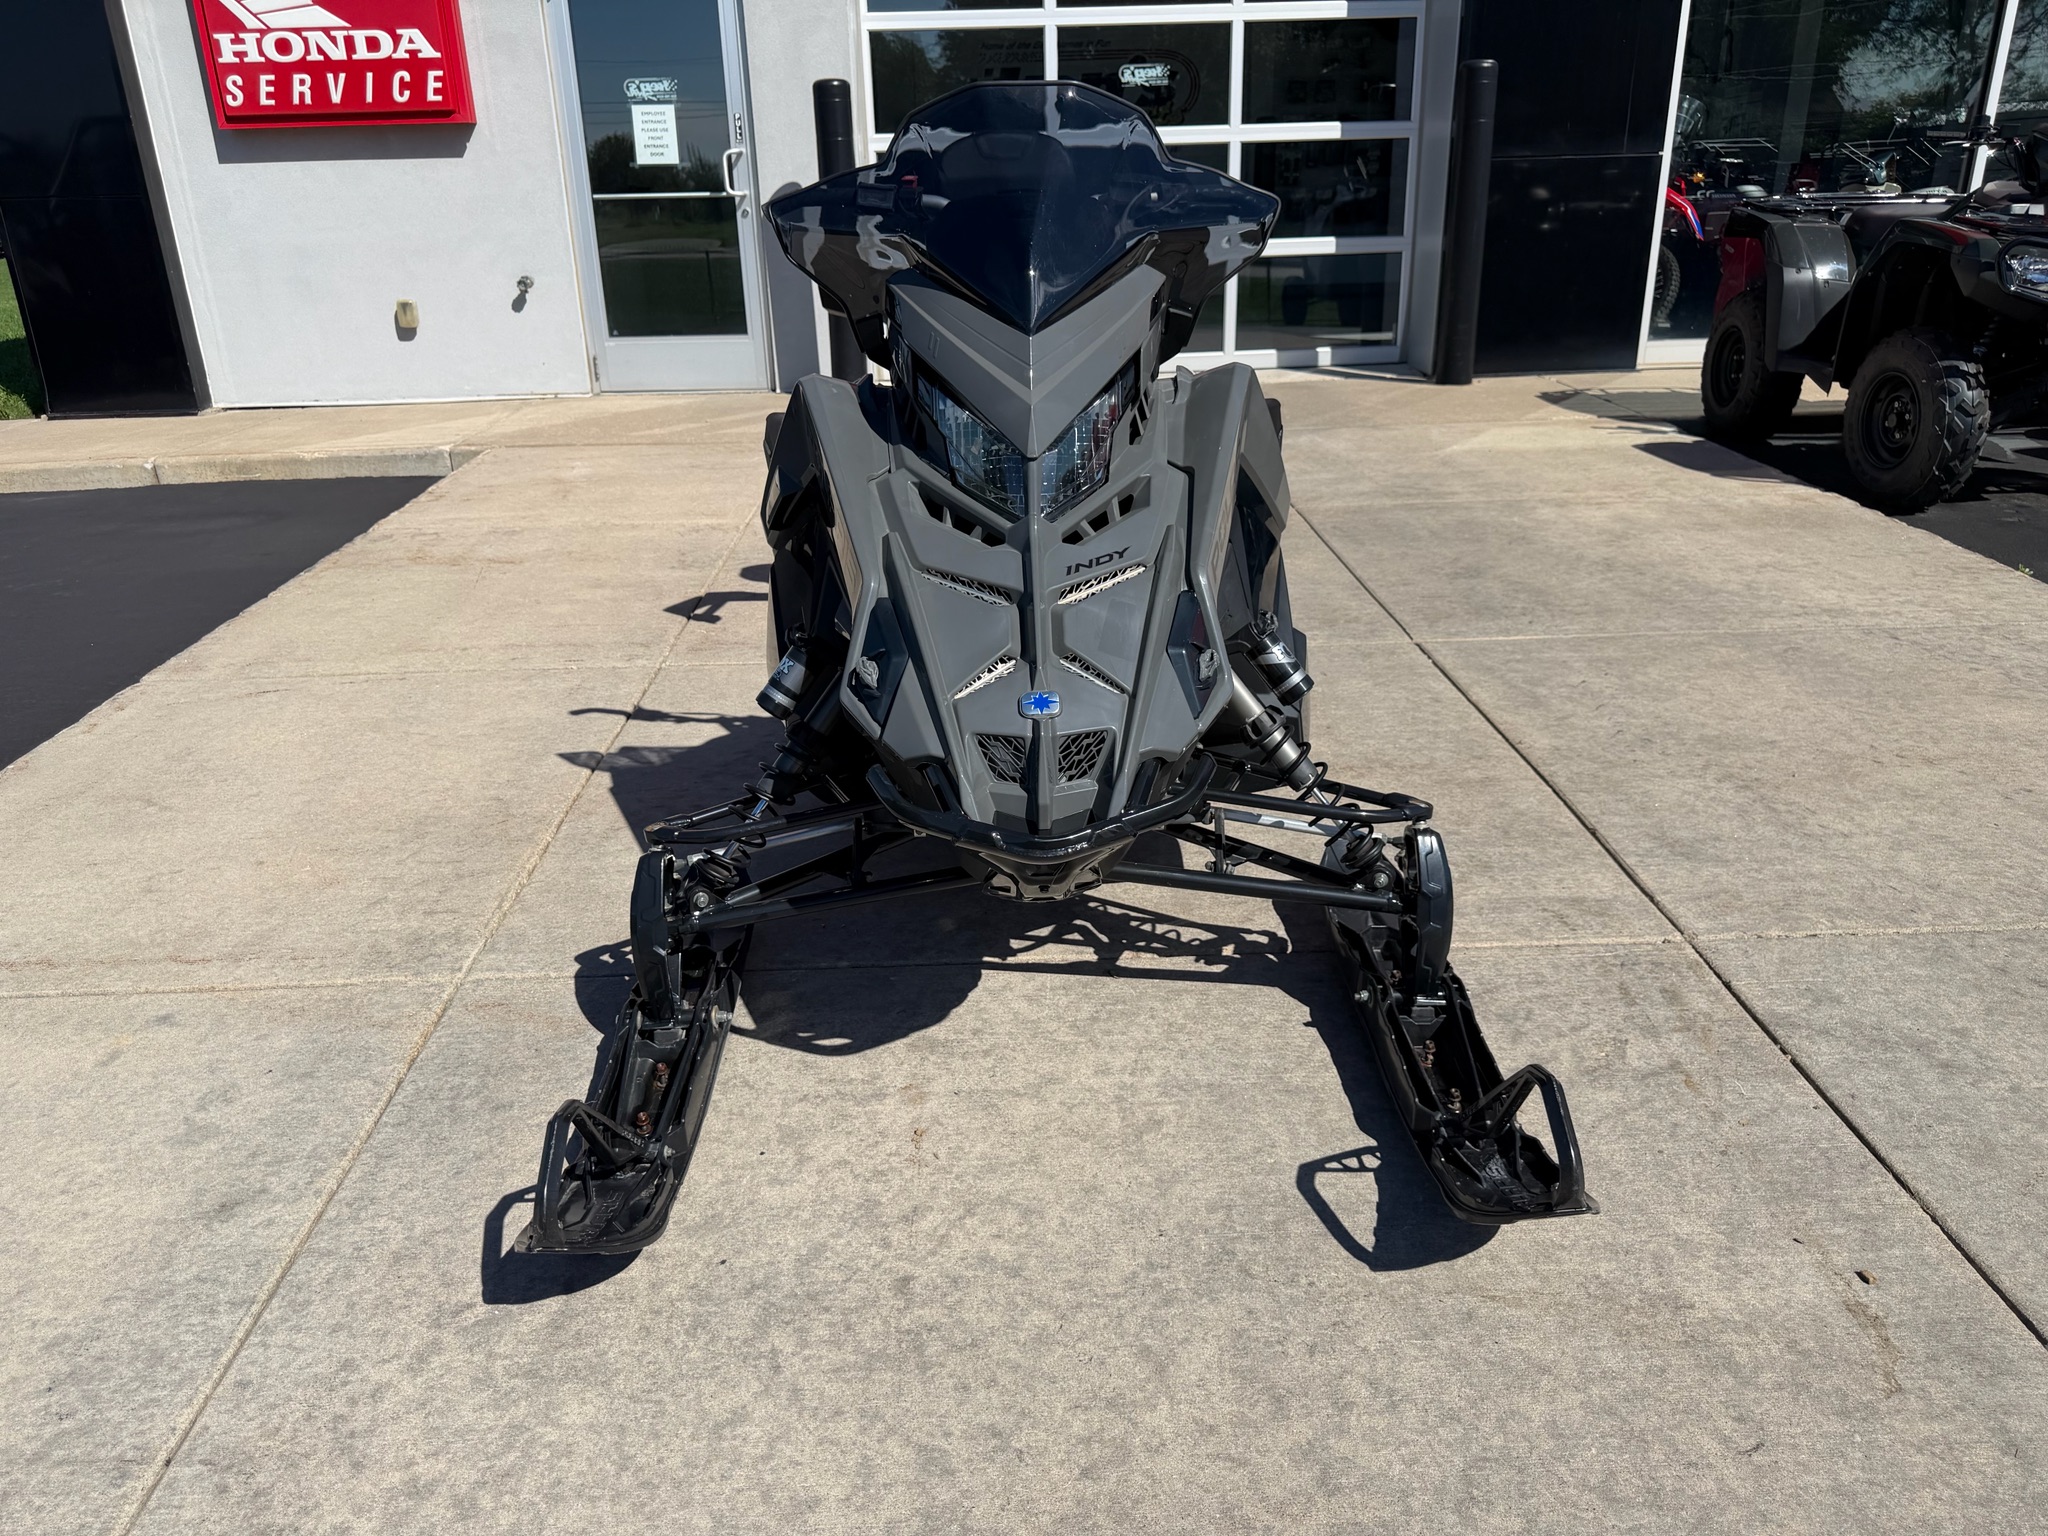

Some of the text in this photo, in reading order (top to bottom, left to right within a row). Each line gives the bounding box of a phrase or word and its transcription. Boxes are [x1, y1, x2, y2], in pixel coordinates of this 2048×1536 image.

[213, 28, 441, 63] HONDA
[225, 70, 445, 107] SERVICE
[1065, 545, 1132, 576] INDY
